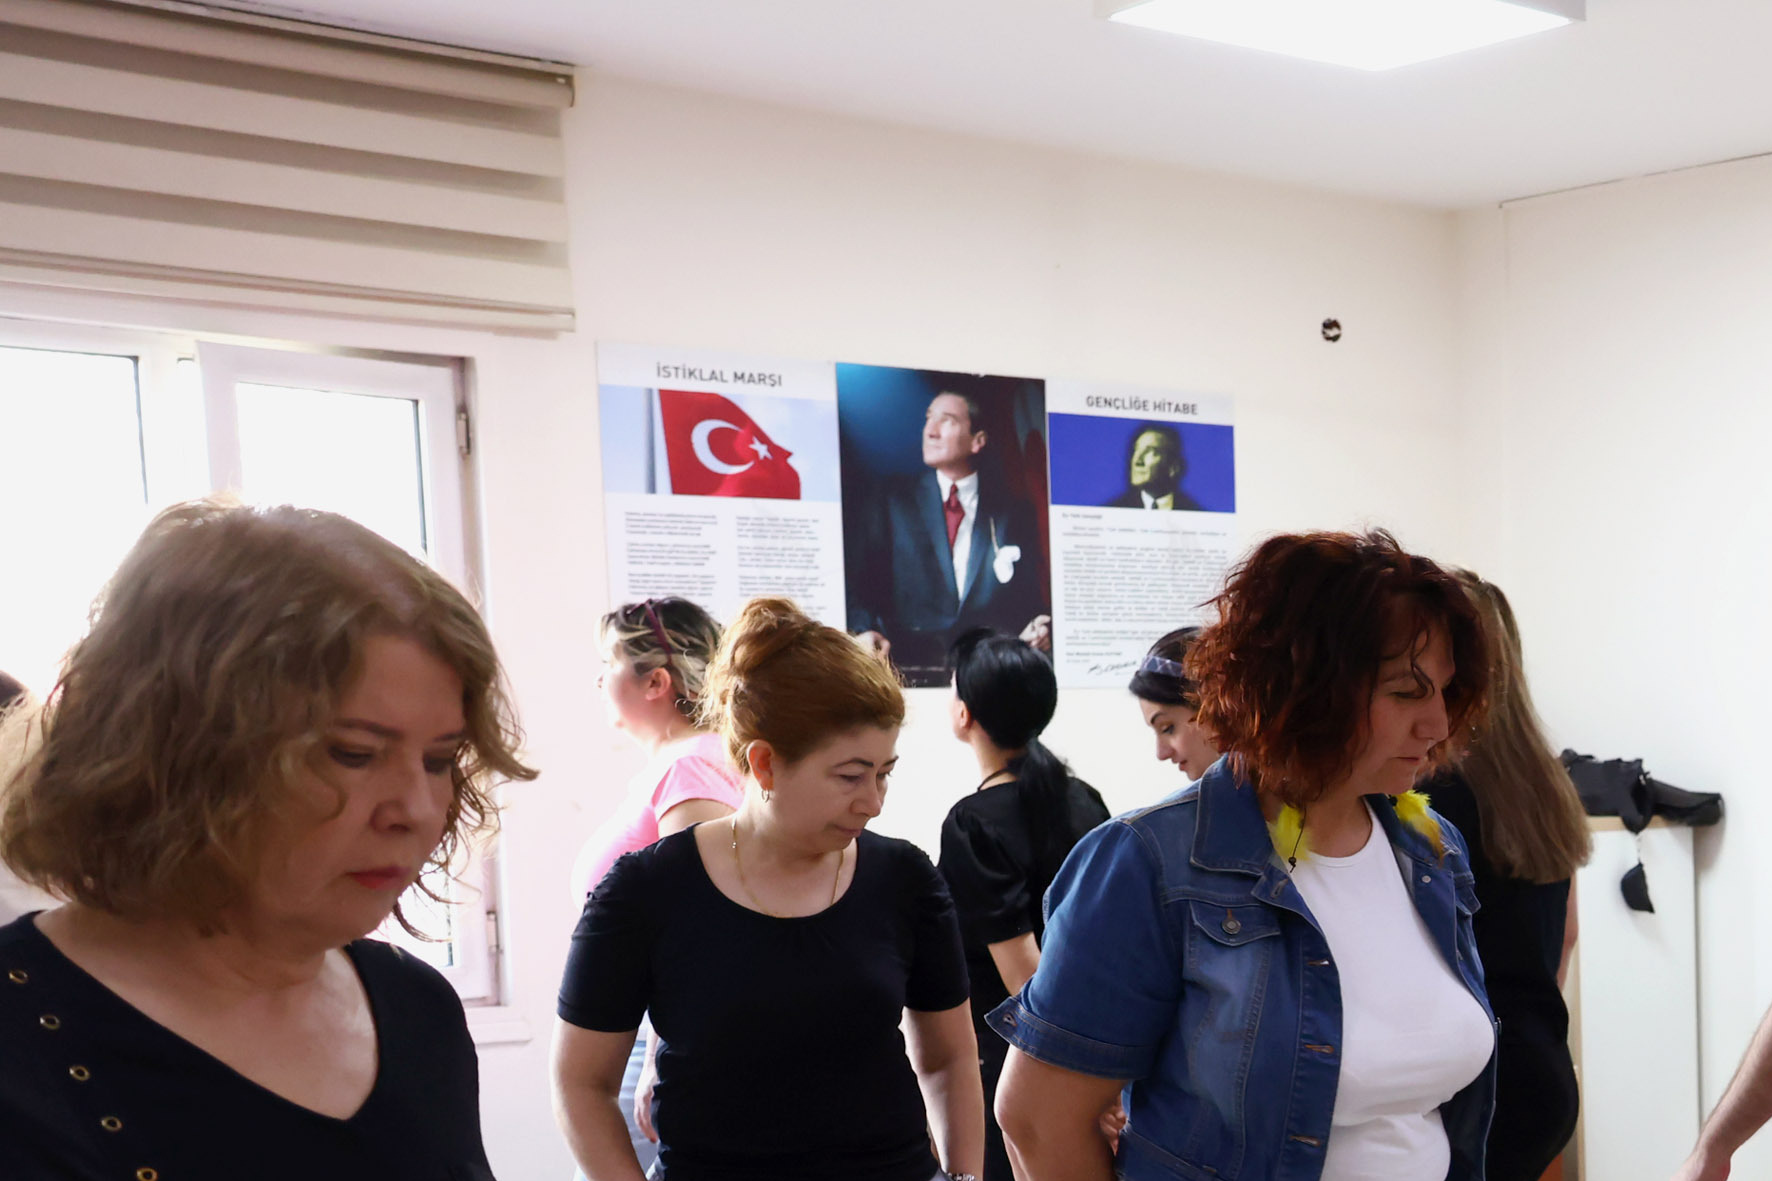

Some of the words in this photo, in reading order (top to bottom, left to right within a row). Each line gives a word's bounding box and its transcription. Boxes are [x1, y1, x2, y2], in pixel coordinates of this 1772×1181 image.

[656, 362, 728, 383] İSTİKLAL
[733, 371, 782, 387] MARŞI
[1086, 395, 1149, 411] GENÇLİĞE
[1153, 399, 1198, 415] HİTABE
